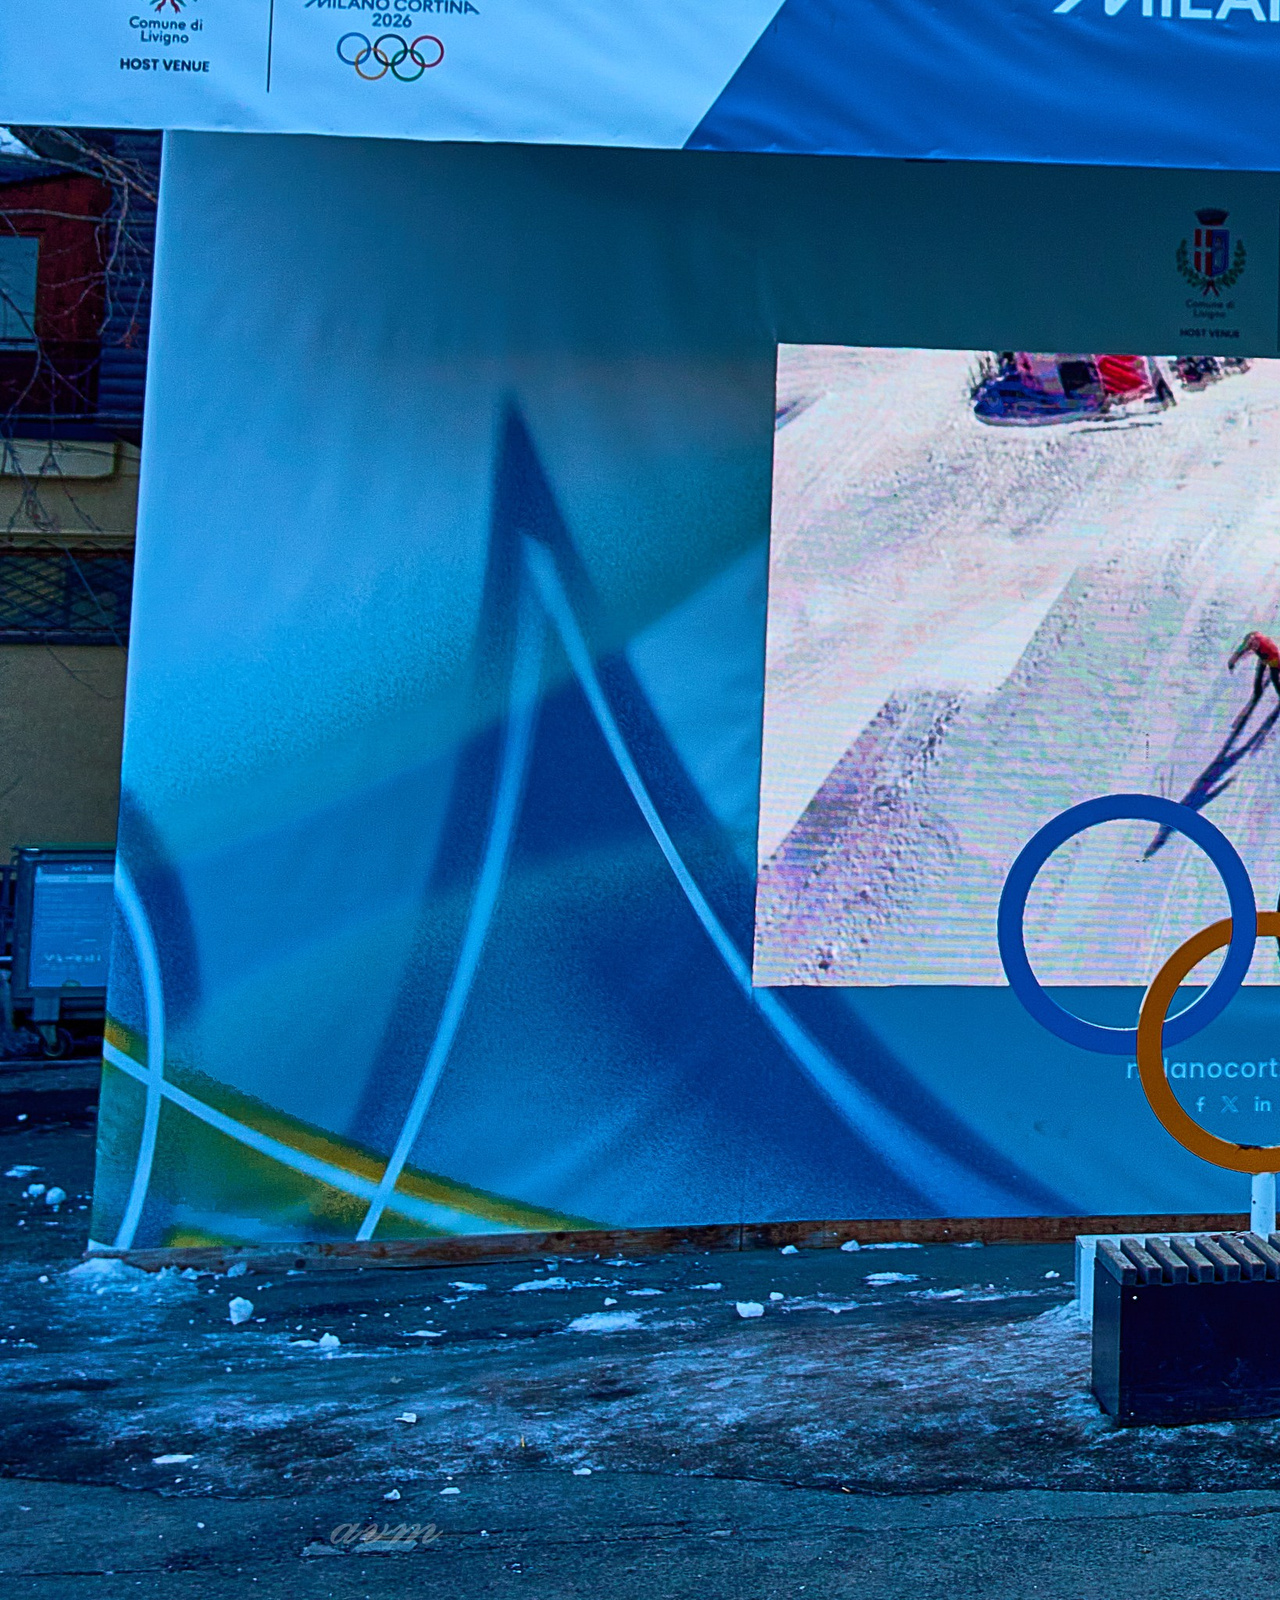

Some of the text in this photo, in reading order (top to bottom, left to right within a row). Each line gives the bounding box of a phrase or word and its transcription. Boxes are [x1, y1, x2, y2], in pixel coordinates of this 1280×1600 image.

[129, 15, 203, 32] Comune di
[372, 12, 412, 28] 2026
[140, 29, 189, 46] Livigno
[120, 57, 210, 73] HOST VENUE
[1180, 328, 1206, 337] HOST
